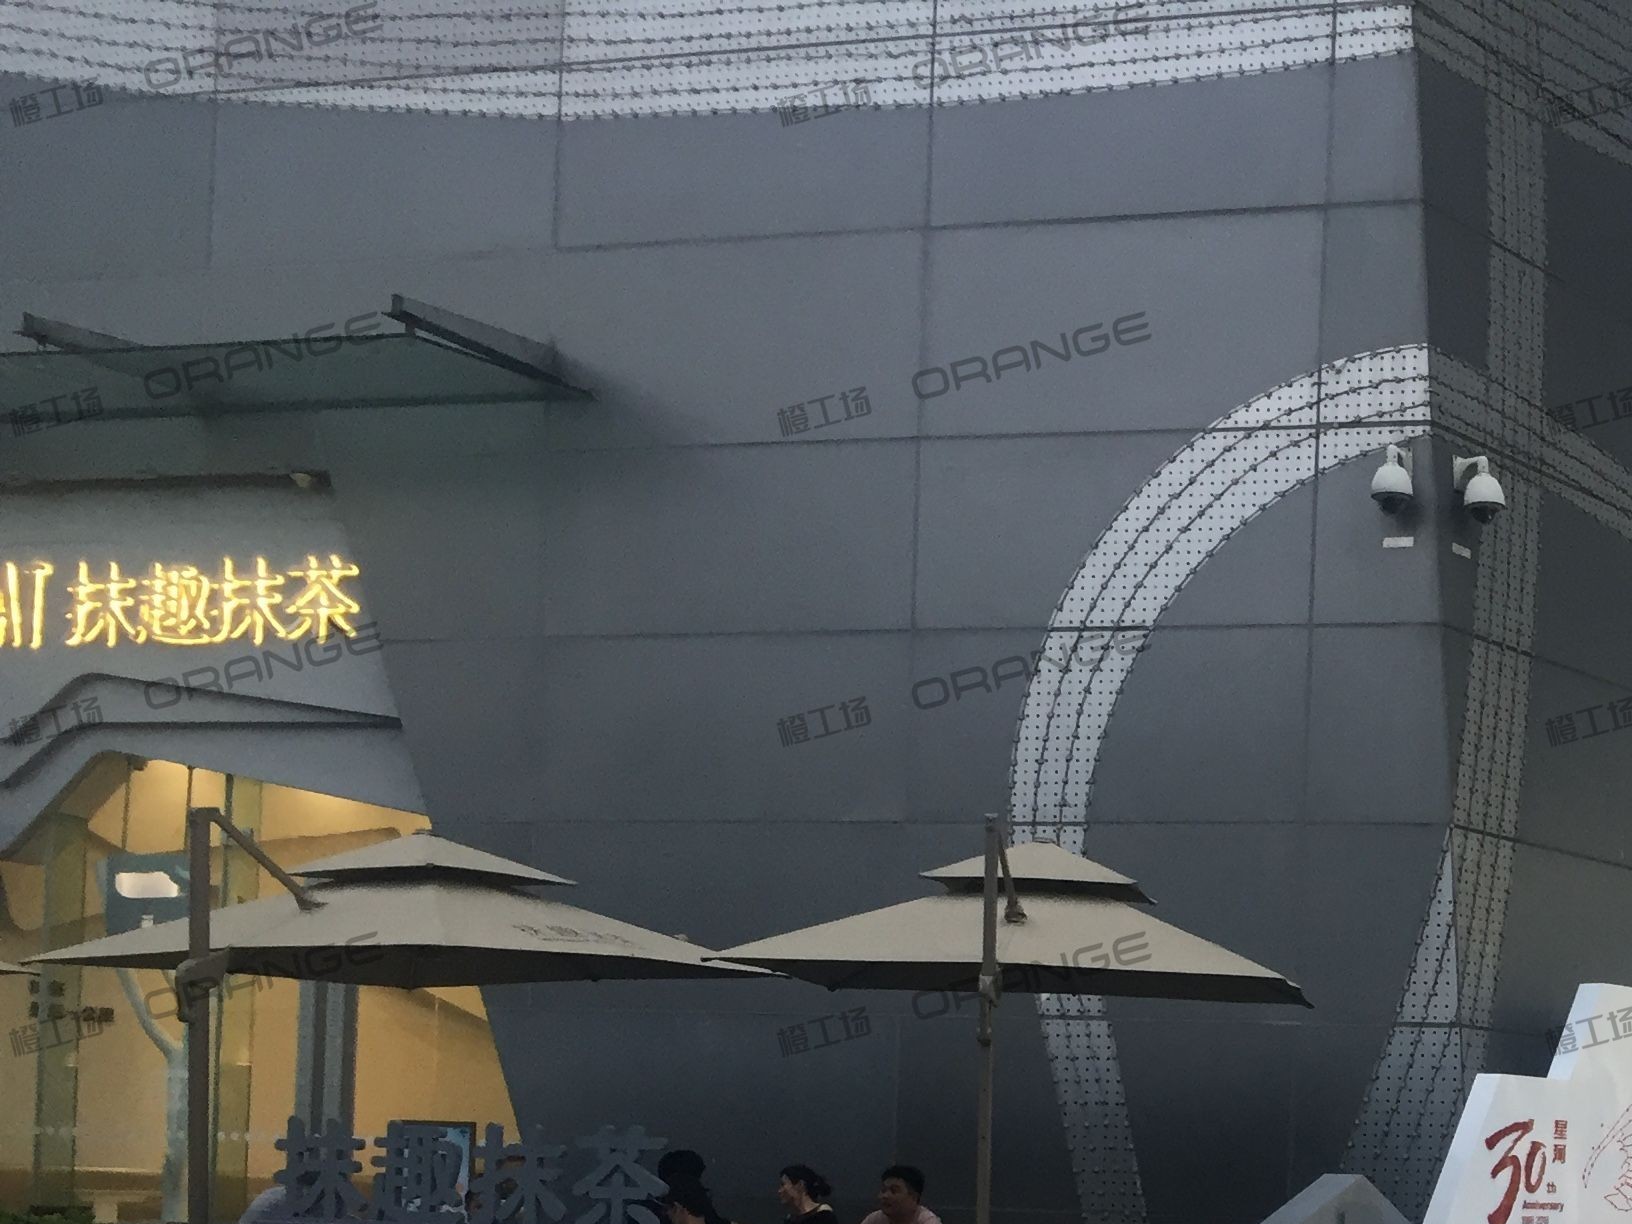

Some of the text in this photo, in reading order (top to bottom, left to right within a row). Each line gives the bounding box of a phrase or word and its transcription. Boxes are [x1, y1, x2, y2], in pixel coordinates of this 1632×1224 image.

[64, 553, 361, 647] 抹趣抹茶
[1551, 1119, 1568, 1164] 星河
